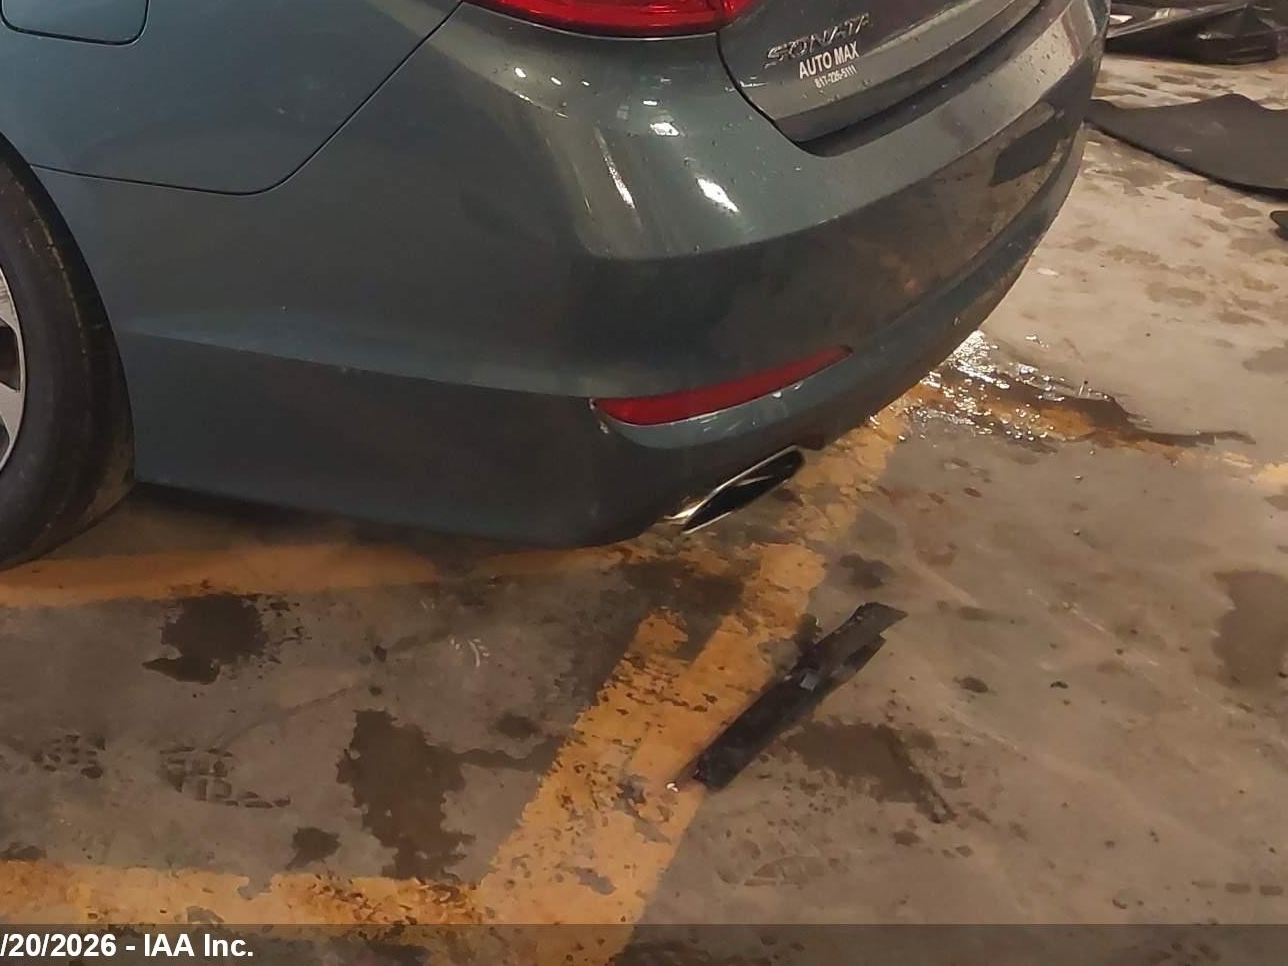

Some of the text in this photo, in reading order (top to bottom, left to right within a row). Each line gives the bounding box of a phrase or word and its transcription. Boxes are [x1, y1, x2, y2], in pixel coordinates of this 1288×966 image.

[764, 12, 873, 69] SONATA
[799, 41, 859, 80] AUTO MAX
